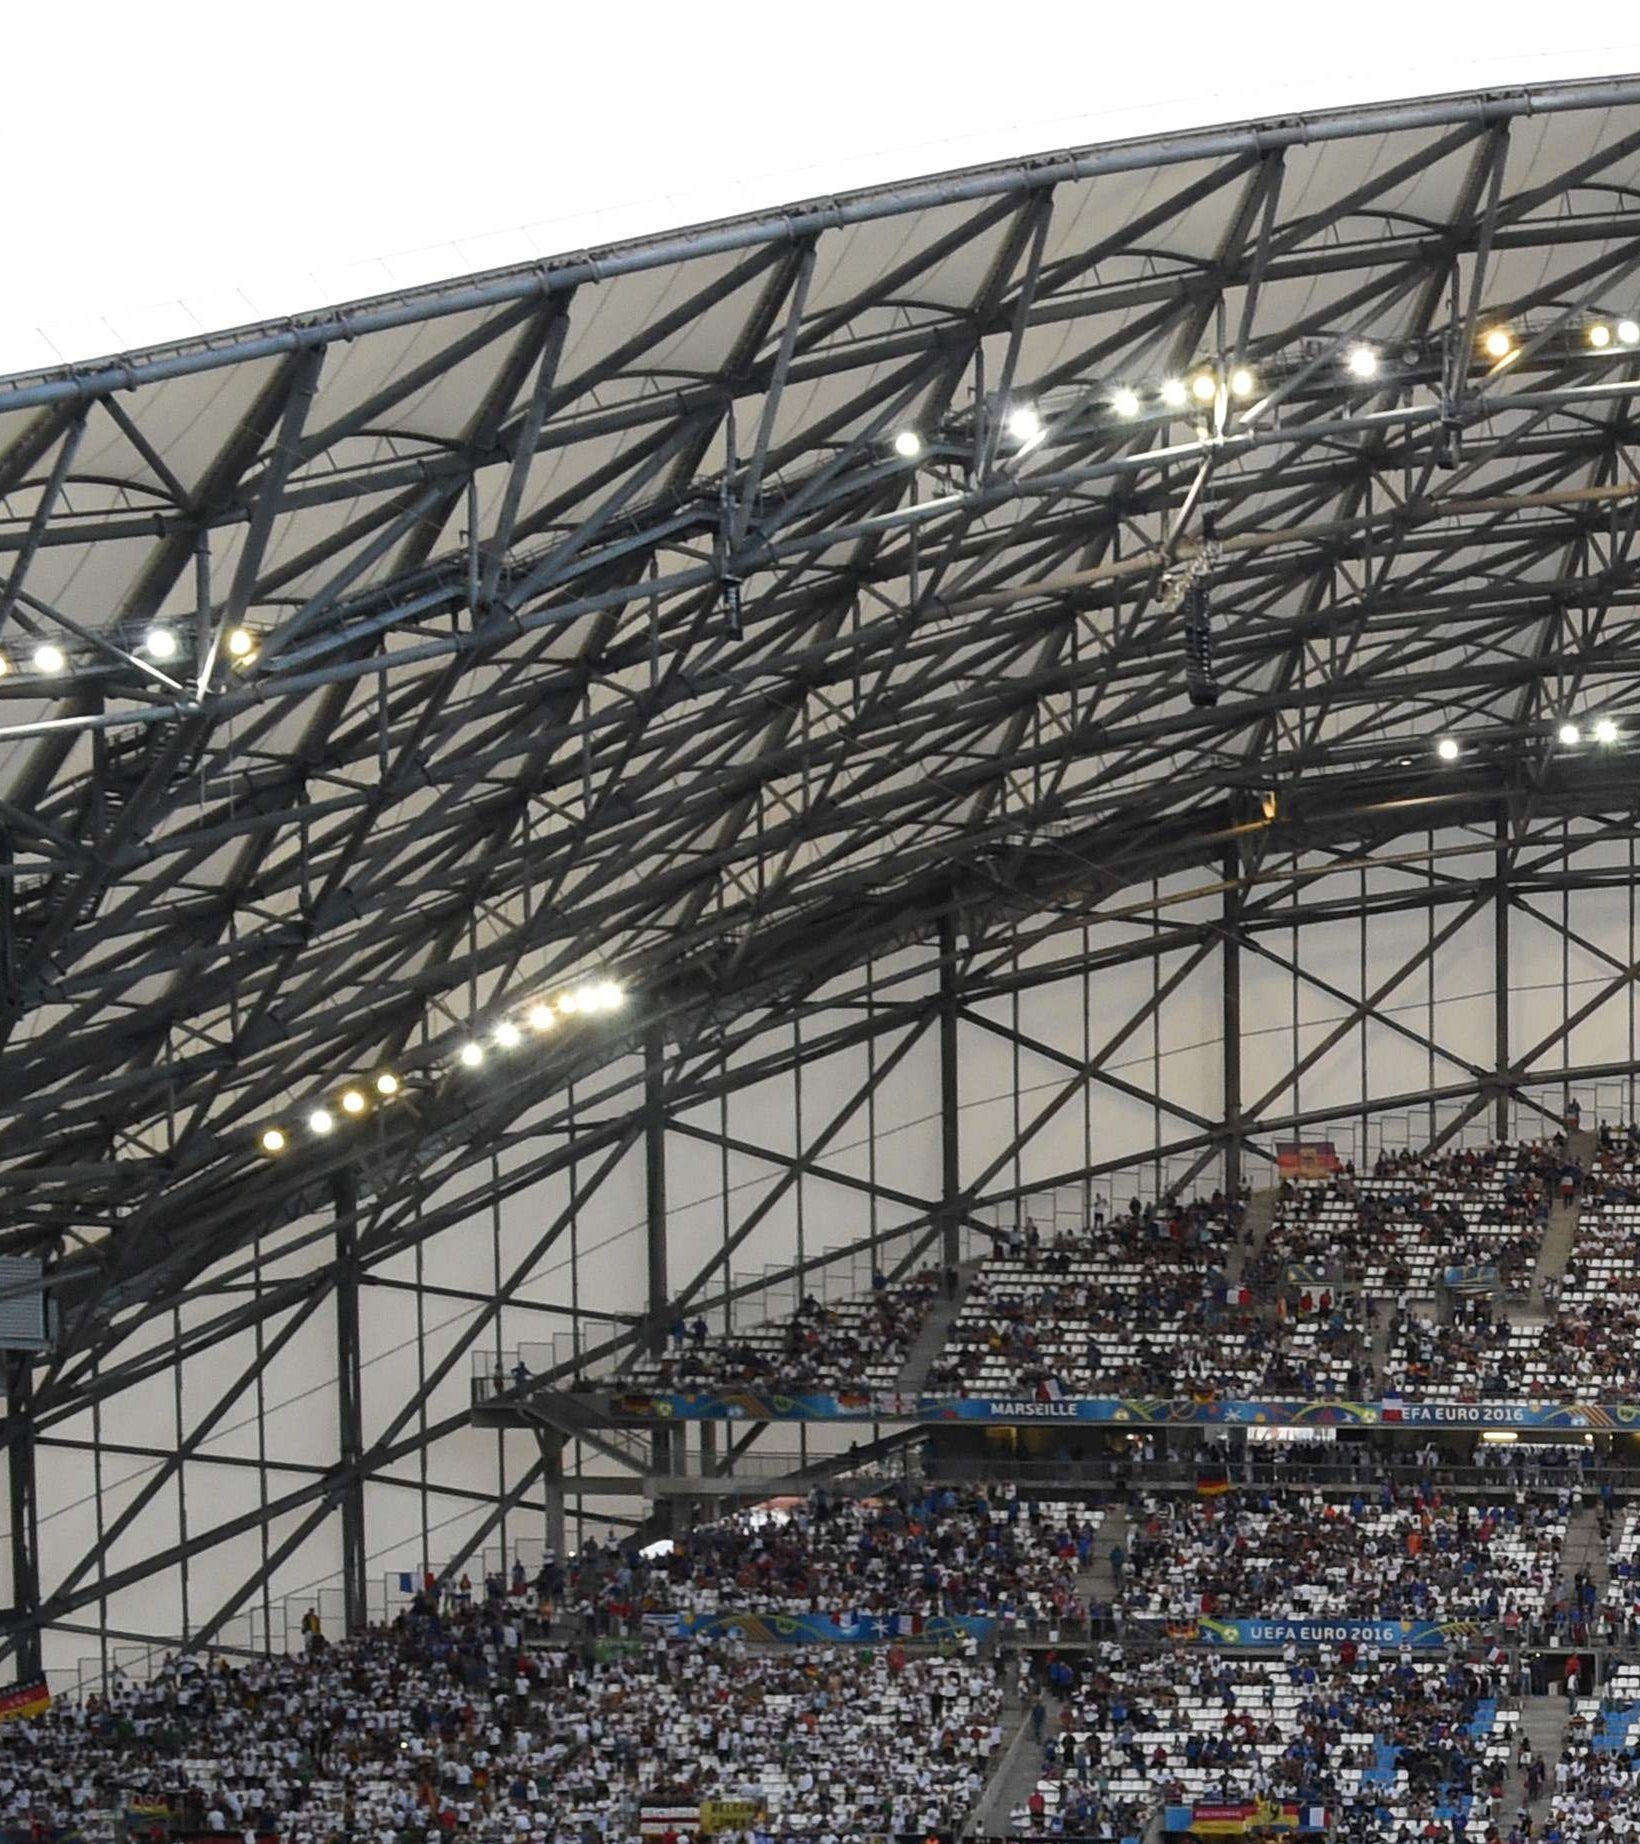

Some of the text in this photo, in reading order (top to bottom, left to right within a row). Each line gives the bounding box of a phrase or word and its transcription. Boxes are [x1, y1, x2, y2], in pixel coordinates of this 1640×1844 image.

[990, 1402, 1078, 1417] MARSEILLE
[1401, 1408, 1524, 1423] EFA EURO 2016
[1251, 1626, 1394, 1642] UEFA EURO 2016
